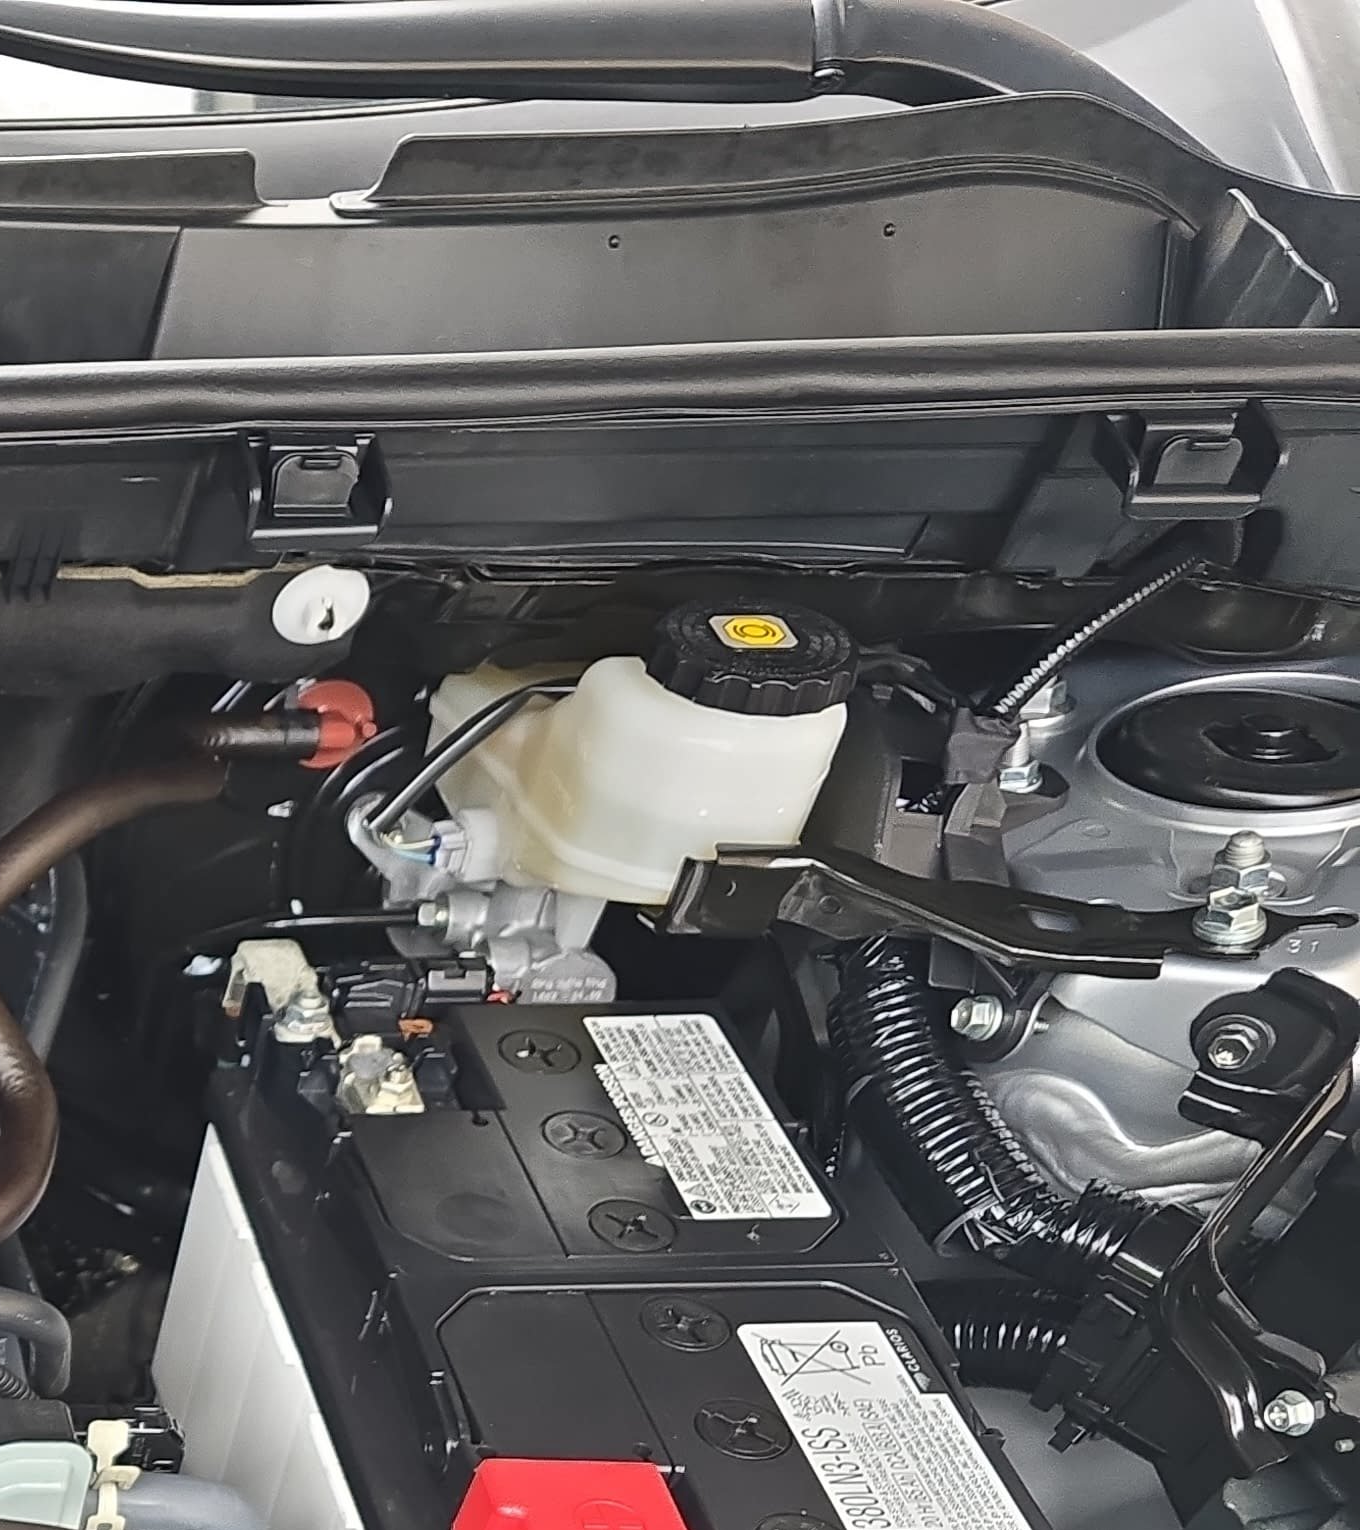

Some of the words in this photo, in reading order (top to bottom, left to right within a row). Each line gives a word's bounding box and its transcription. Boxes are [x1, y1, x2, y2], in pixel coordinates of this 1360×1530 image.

[855, 1343, 887, 1370] Pb
[886, 1327, 923, 1374] CLARIOS
[800, 1425, 892, 1530] 380LN3-ISS
